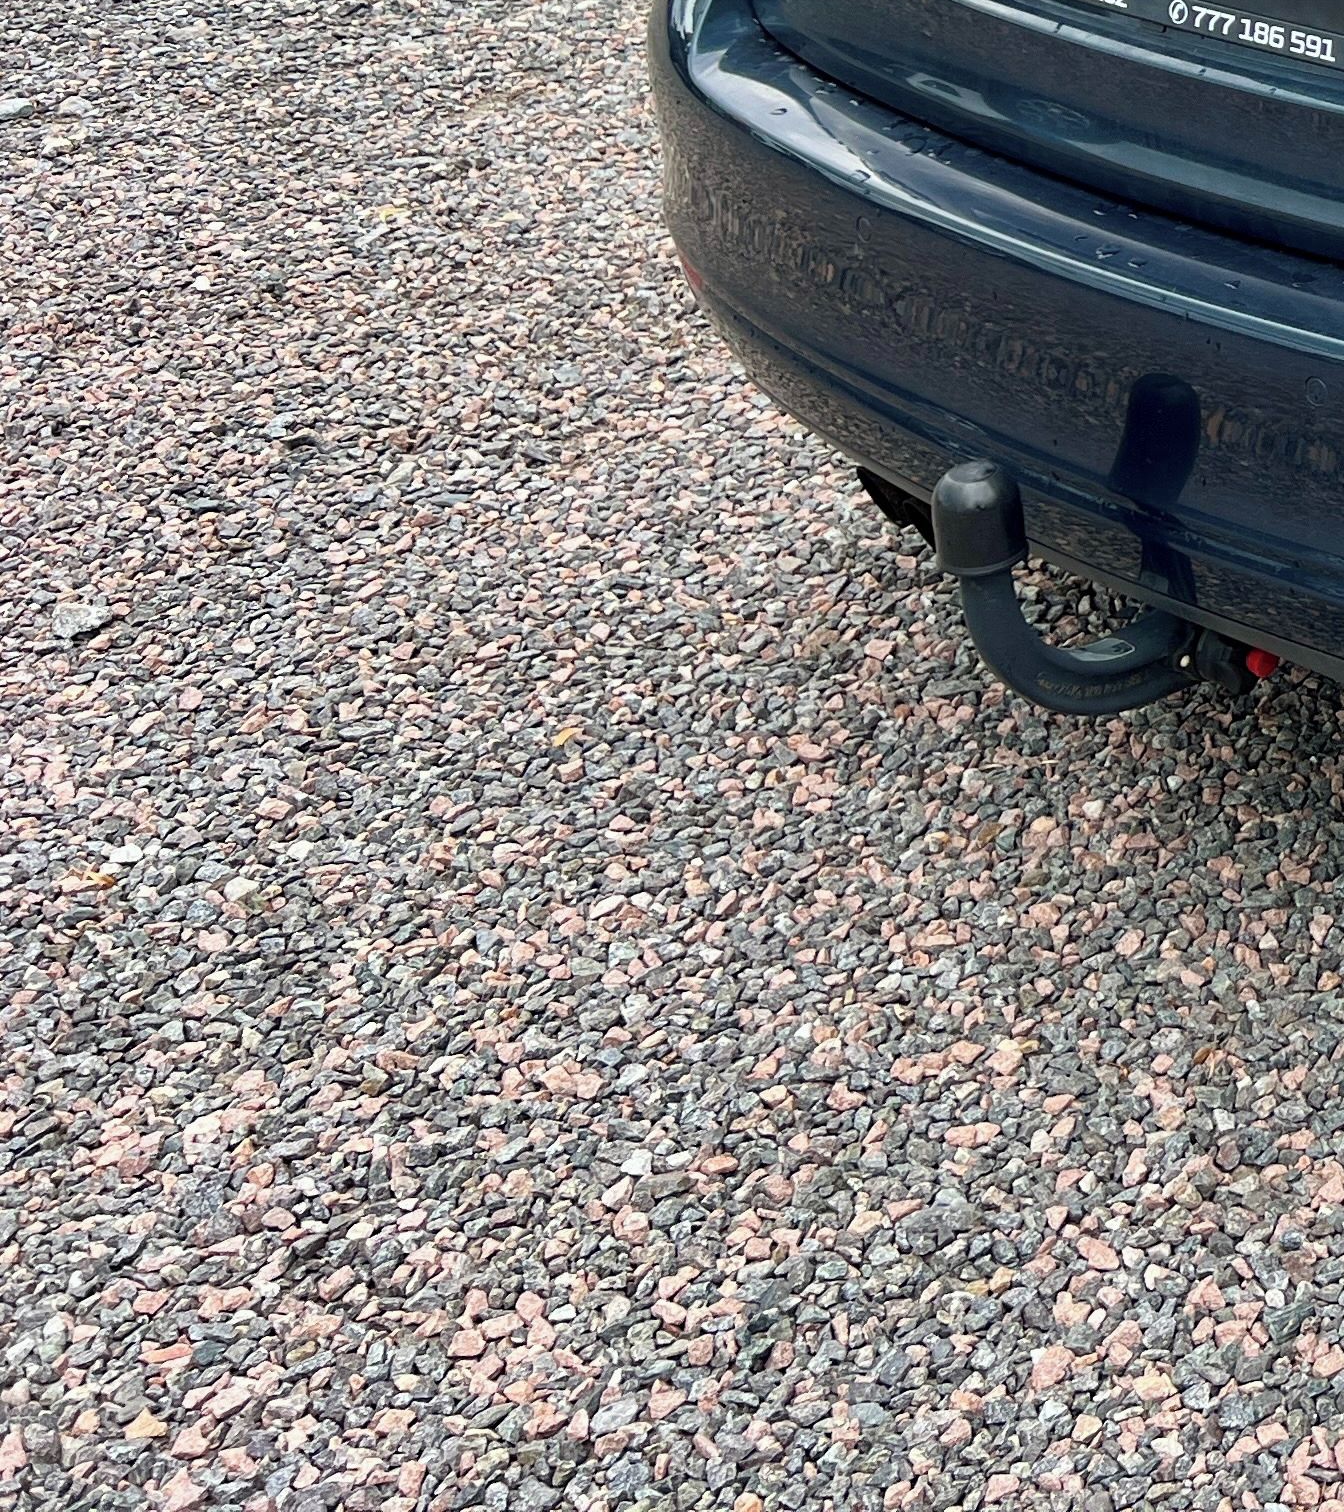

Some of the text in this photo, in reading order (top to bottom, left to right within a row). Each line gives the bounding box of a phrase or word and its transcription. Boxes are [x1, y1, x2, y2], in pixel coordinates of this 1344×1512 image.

[1192, 5, 1236, 35] 777
[1238, 18, 1285, 49] 186
[1289, 30, 1336, 63] 591
